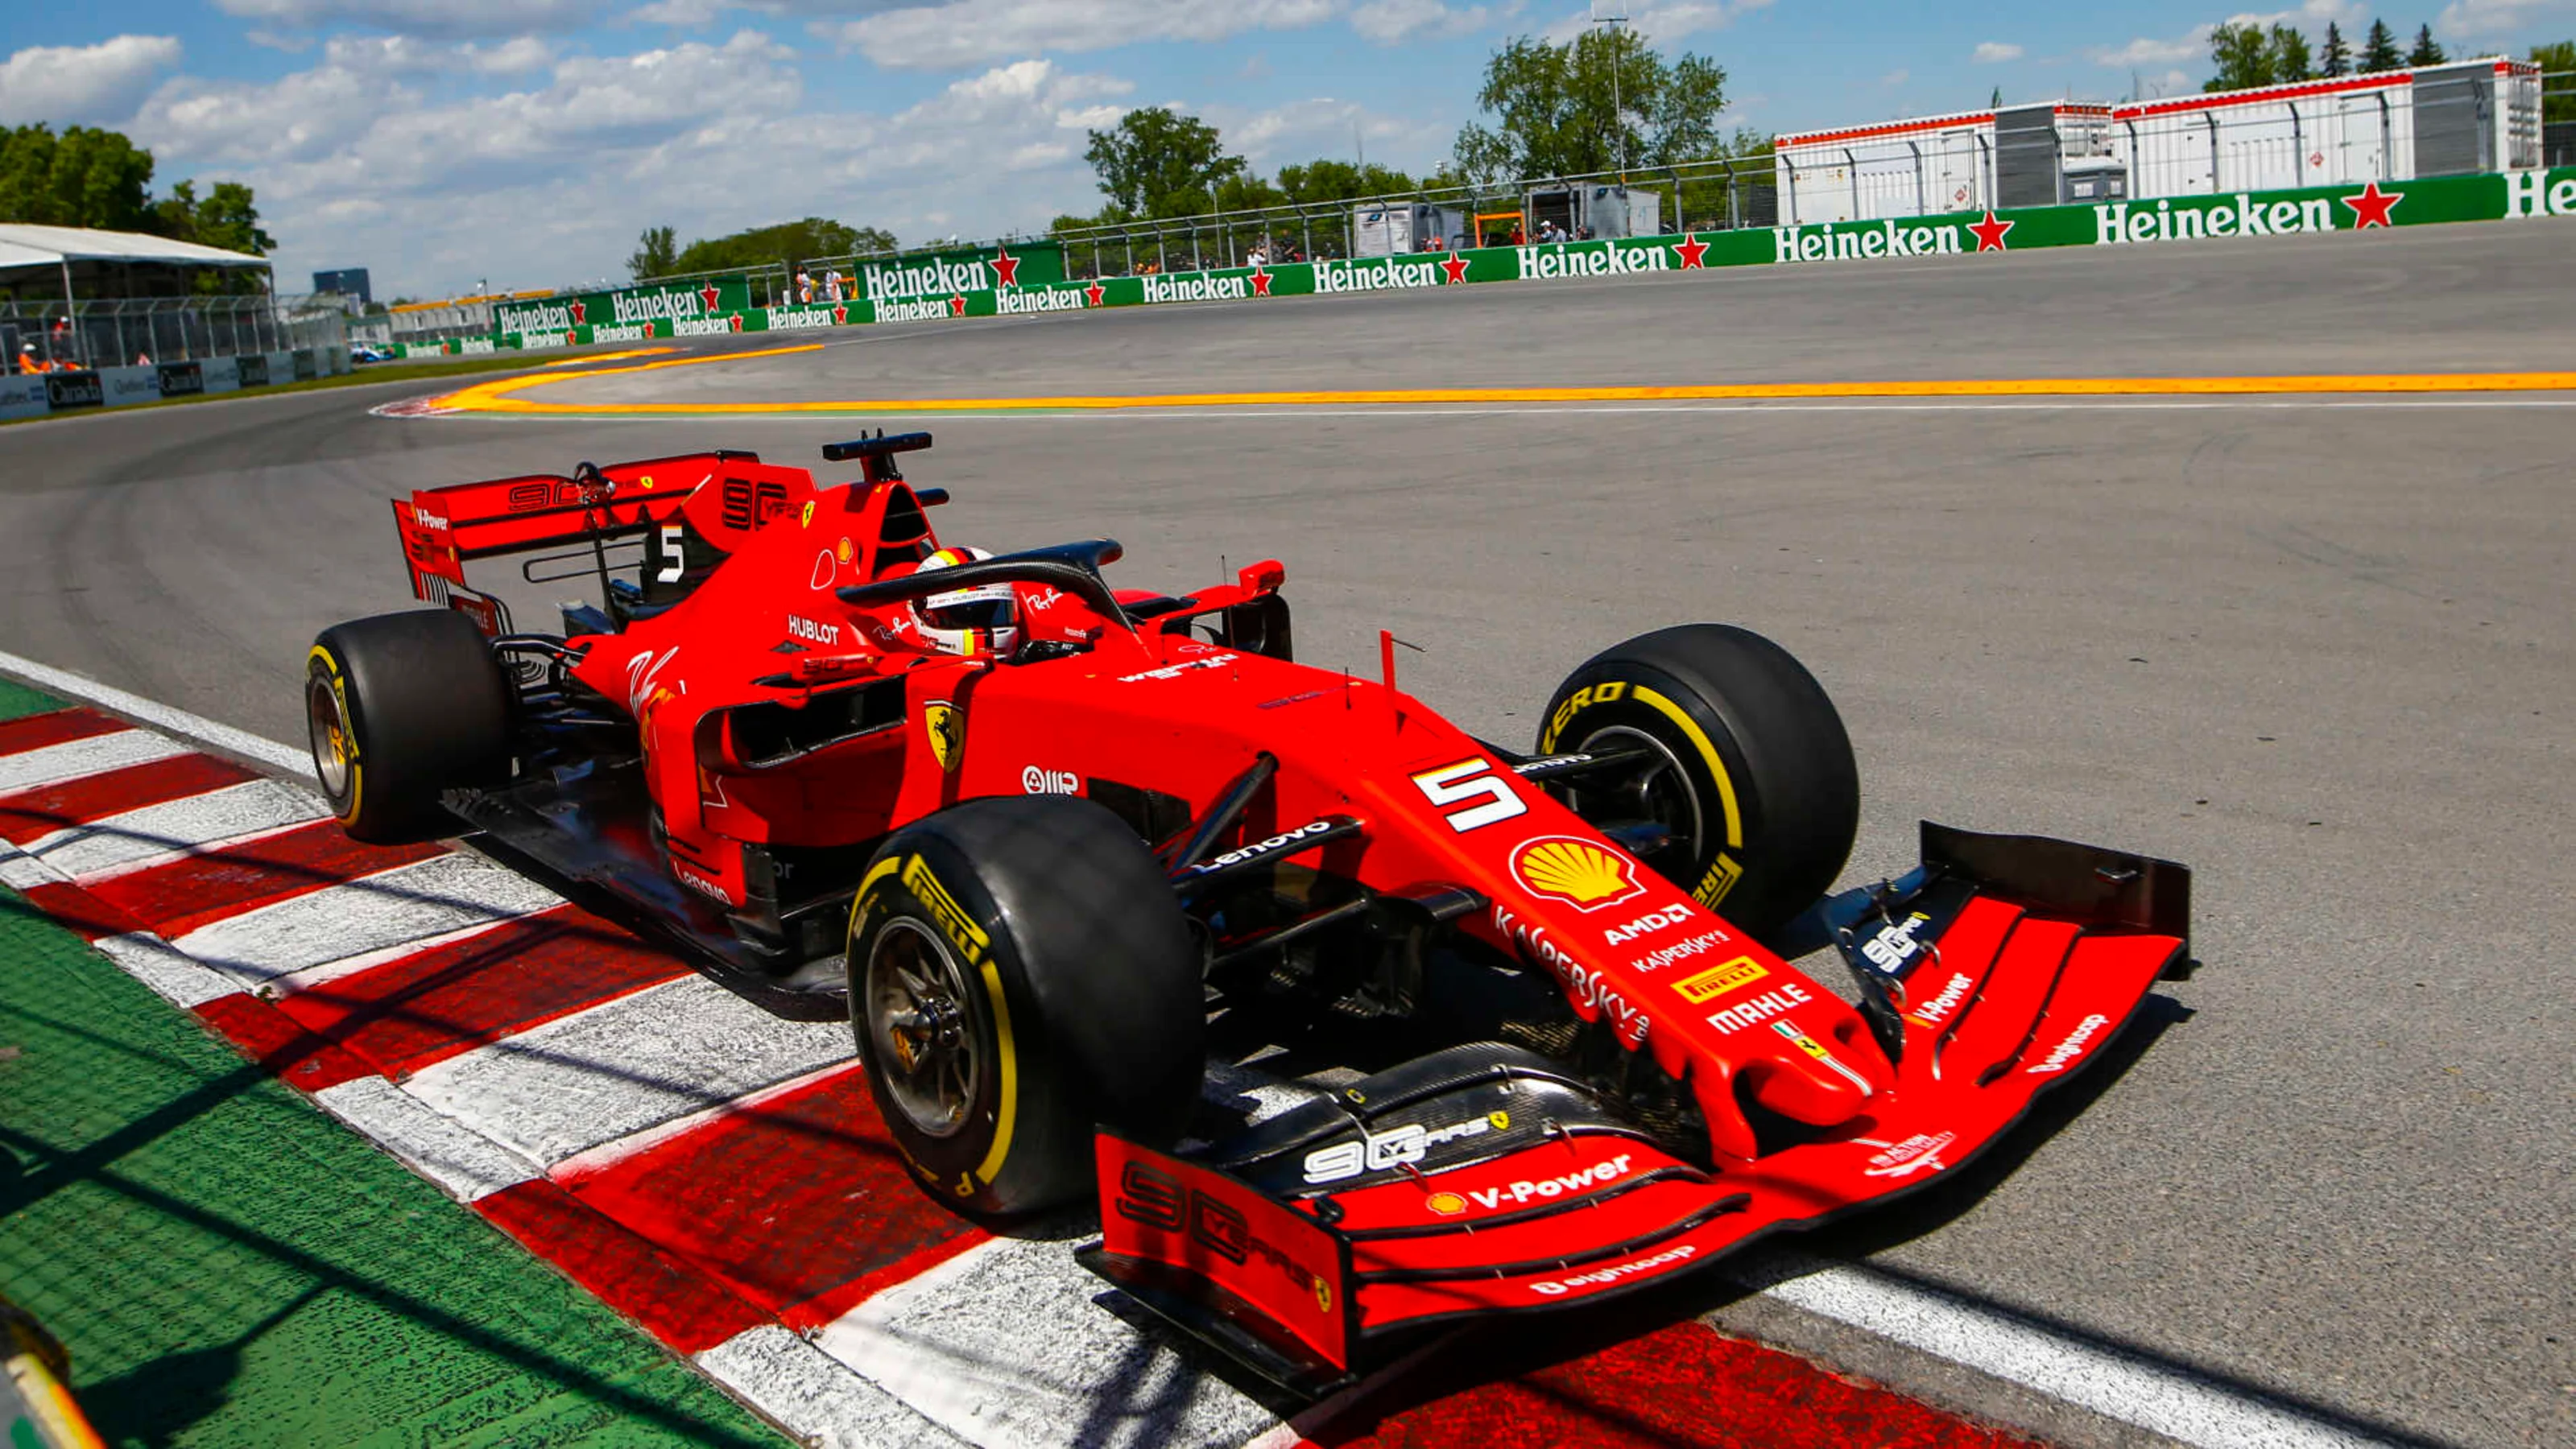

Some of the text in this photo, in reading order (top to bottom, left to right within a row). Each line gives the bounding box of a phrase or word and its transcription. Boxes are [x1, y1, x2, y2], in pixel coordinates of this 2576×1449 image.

[2094, 193, 2336, 244] Heineken
[1772, 221, 1963, 262] Heineken
[863, 256, 989, 300] Heineken
[1312, 257, 1437, 293] Heineken
[1516, 242, 1668, 280] Heineken
[611, 287, 699, 322] Heineken
[995, 284, 1083, 314] Heineken
[1142, 270, 1247, 303] Heineken
[498, 303, 570, 334] Heineken
[672, 314, 730, 336] Heineken
[767, 304, 832, 330] Heineken
[873, 296, 949, 323] Heineken
[592, 320, 643, 345] Heineken
[416, 506, 449, 531] V-Power
[657, 525, 684, 583] 5
[788, 614, 839, 646] HUBLOT
[1541, 680, 1627, 755] ZERO
[1408, 757, 1529, 834] 5
[1191, 819, 1331, 874] Lenovo
[901, 852, 990, 965] PIRELLI
[1604, 912, 1670, 946] AMD
[1631, 931, 1718, 972] KASPERSKY
[1683, 961, 1758, 997] PIRELLI
[1912, 972, 1974, 1022] V-Power
[1706, 983, 1813, 1035] MAHLE
[1303, 1124, 1426, 1184] 90
[1468, 1153, 1634, 1210] V-Power
